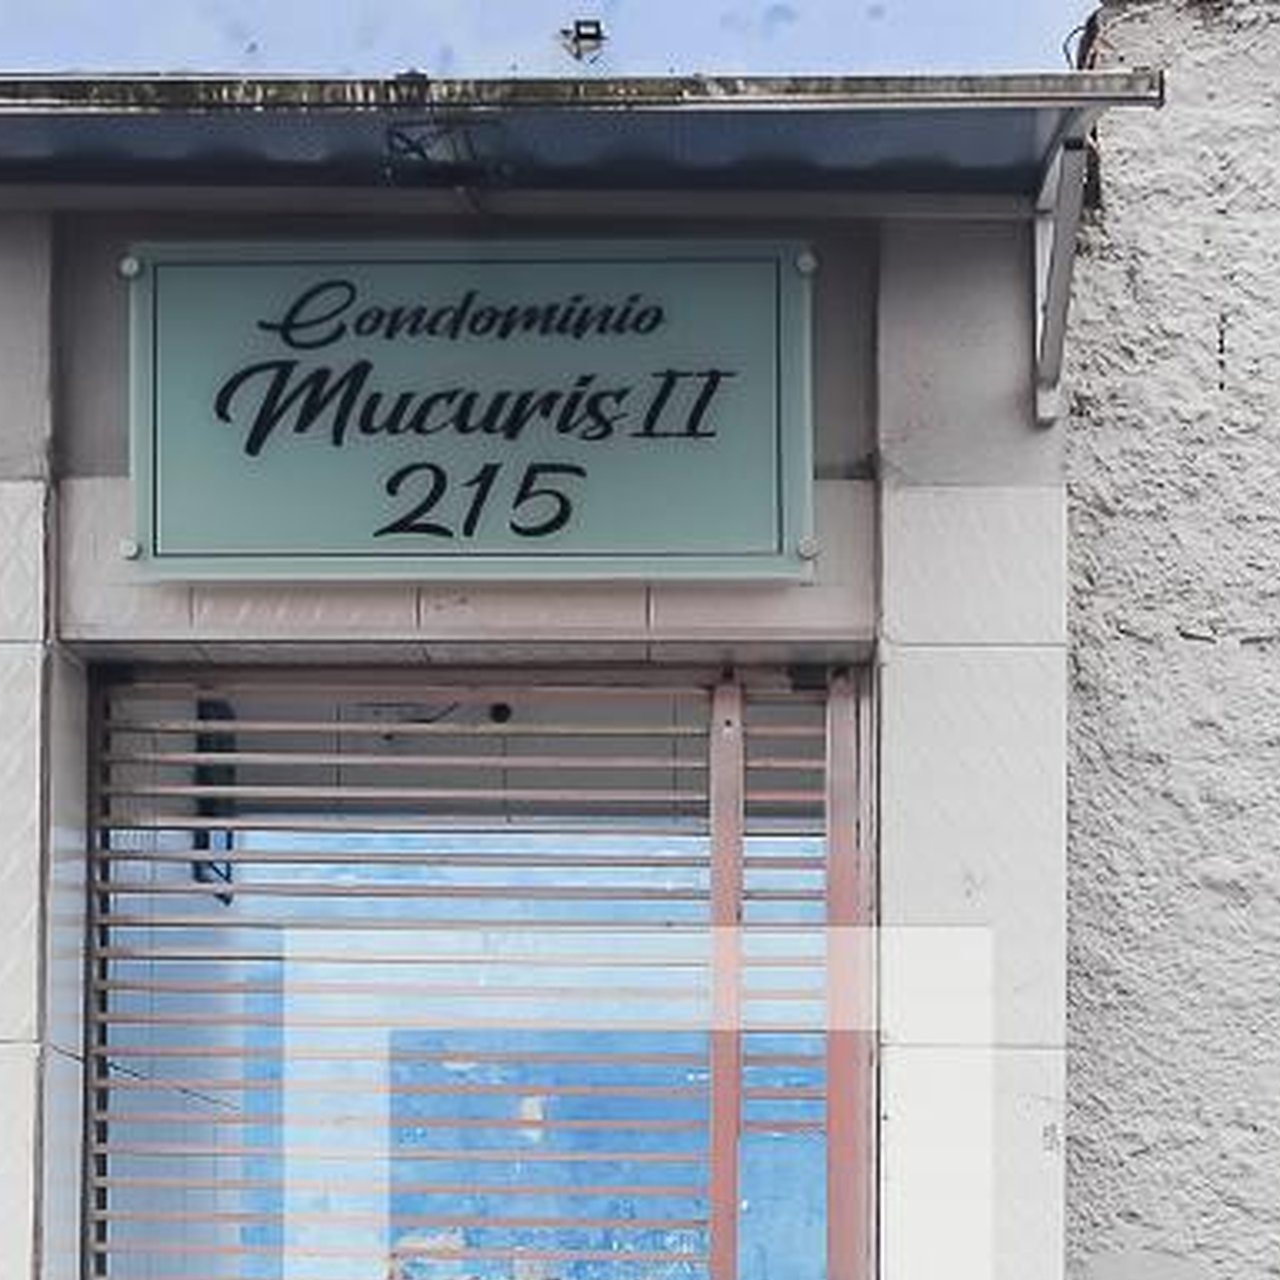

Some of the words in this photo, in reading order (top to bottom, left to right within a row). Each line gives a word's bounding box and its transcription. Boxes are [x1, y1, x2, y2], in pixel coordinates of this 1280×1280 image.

[215, 359, 628, 456] Mucuris
[630, 368, 735, 439] II
[373, 462, 587, 538] 215
